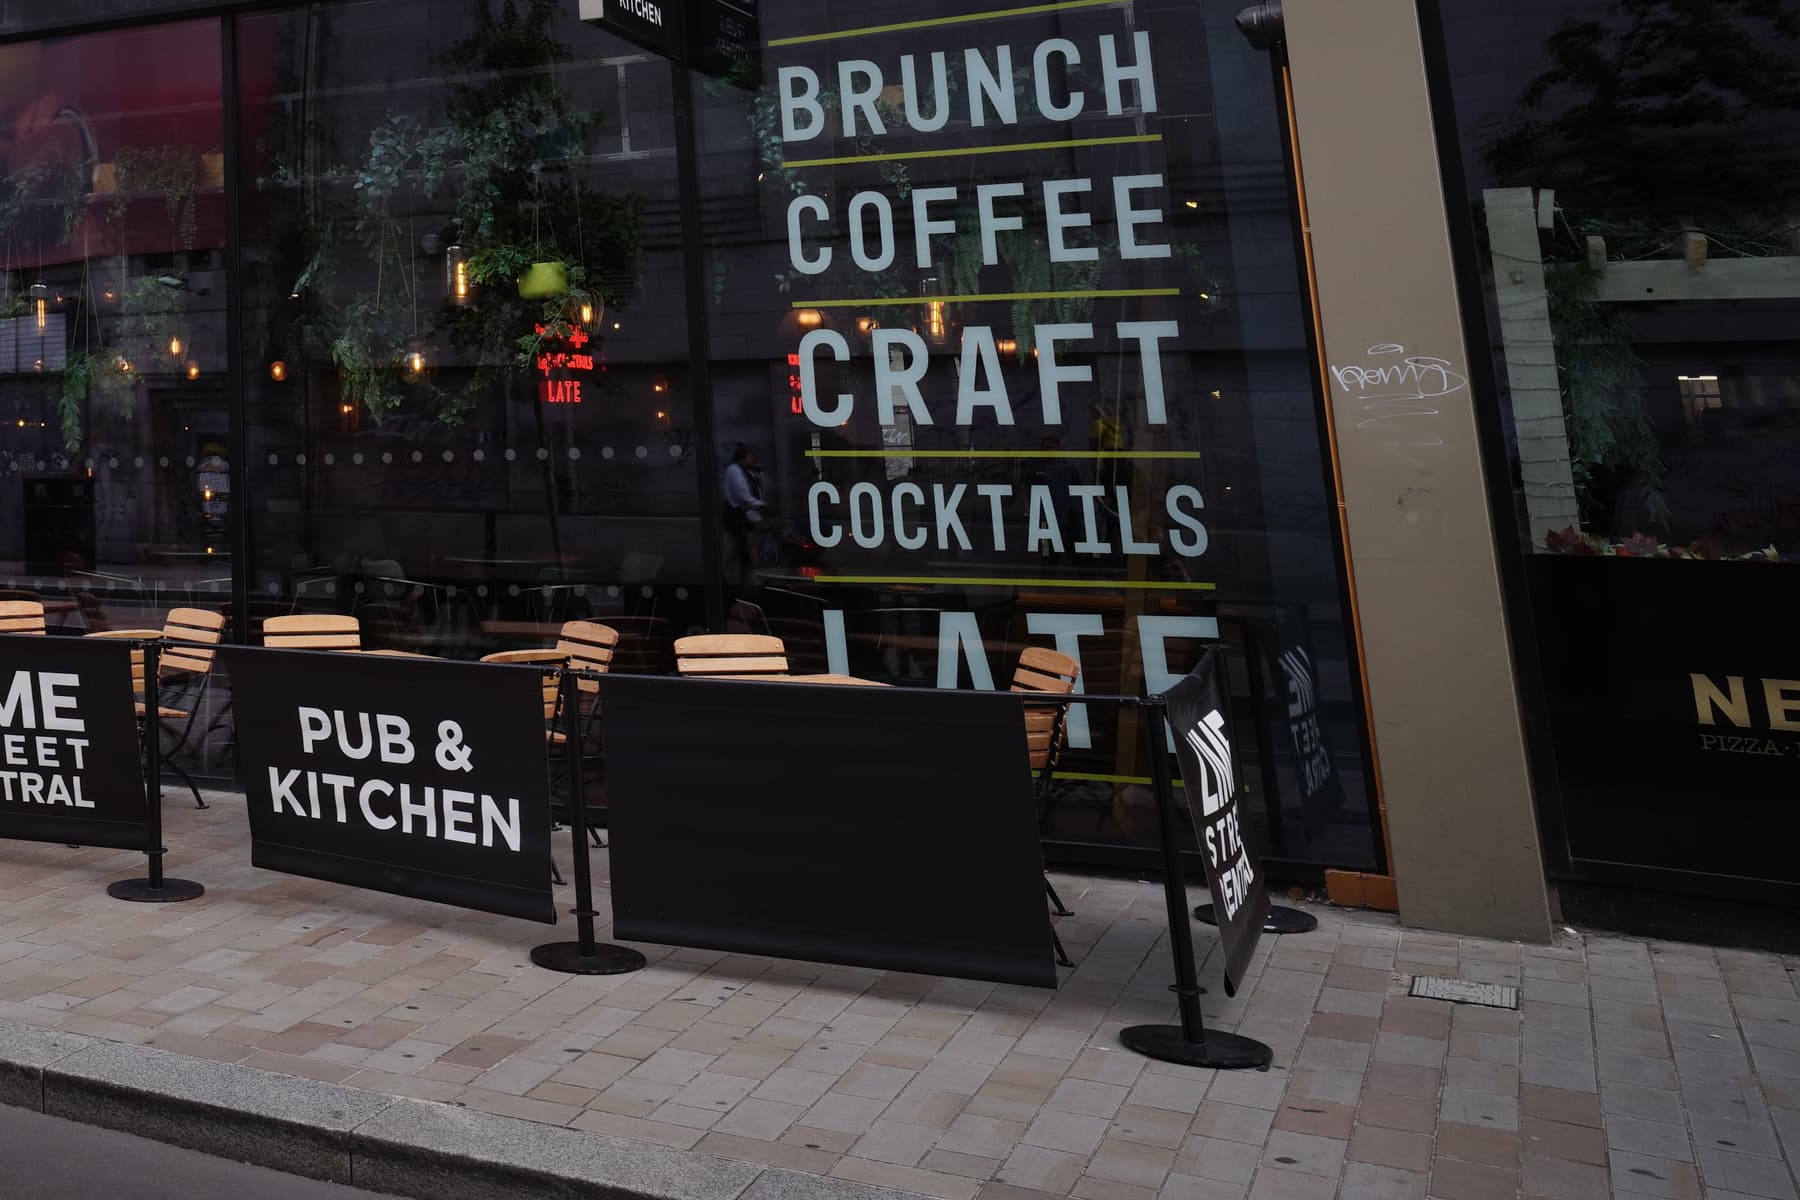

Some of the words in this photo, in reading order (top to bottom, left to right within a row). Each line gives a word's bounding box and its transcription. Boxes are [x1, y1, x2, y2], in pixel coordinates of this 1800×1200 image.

[777, 30, 1158, 143] BRUNCH
[786, 173, 1172, 275] COFFEE
[547, 380, 582, 404] LATE
[800, 320, 1180, 428] CRAFT
[807, 481, 1209, 557] COCKTAILS
[1689, 673, 1800, 732] NE
[298, 706, 416, 765] PUB
[434, 718, 474, 774] &
[1698, 734, 1784, 757] PIZZA
[267, 766, 522, 853] KITCHEN
[1204, 808, 1242, 869] STRE
